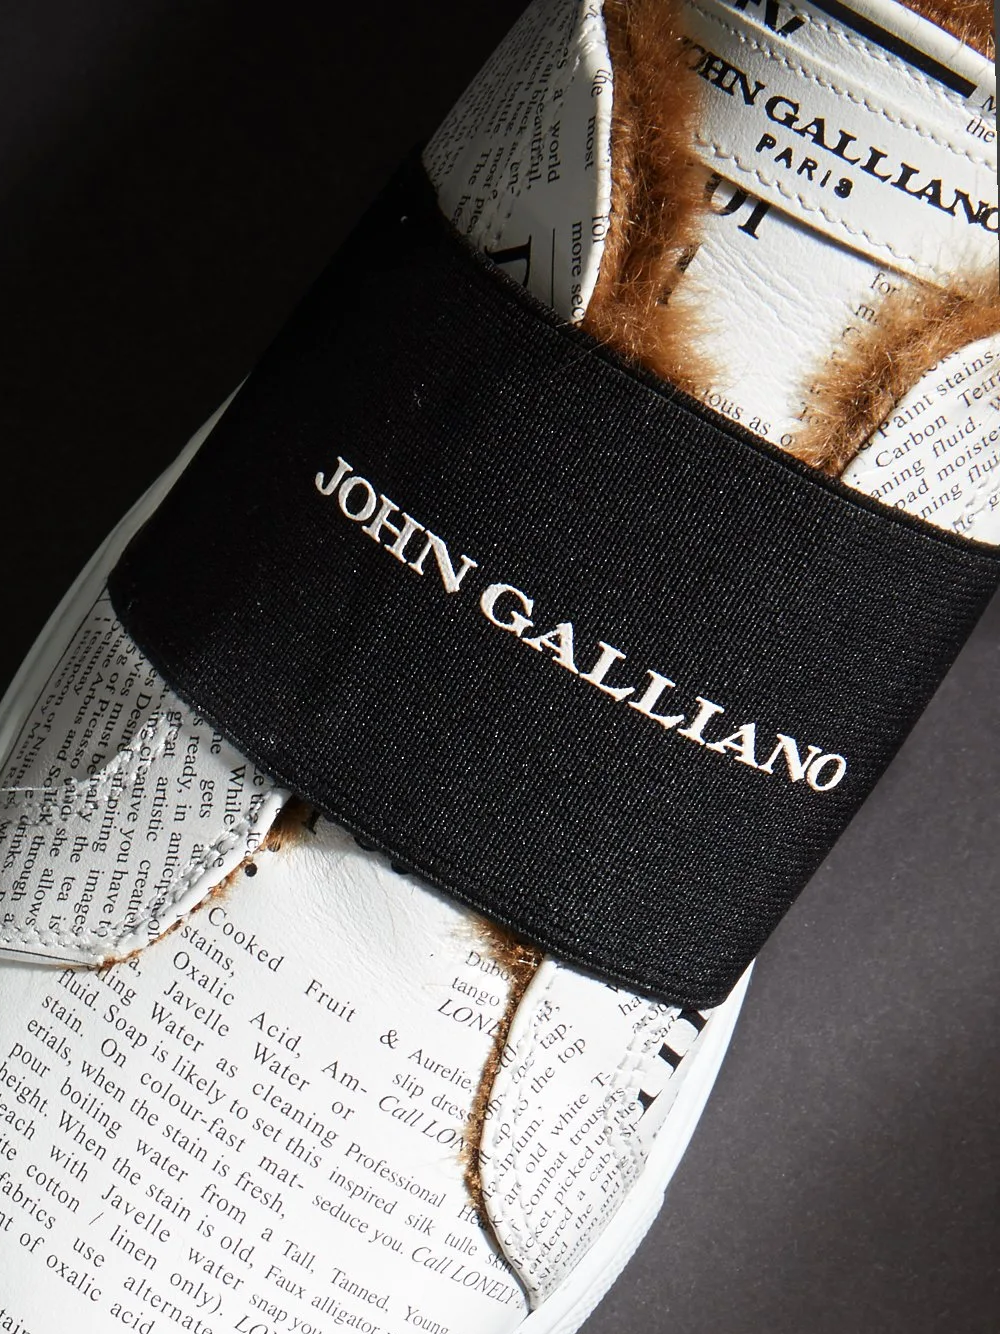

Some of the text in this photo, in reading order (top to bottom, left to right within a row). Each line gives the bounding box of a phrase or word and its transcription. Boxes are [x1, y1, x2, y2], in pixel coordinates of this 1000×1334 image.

[547, 119, 561, 184] world
[584, 115, 597, 171] most
[966, 117, 995, 144] the
[755, 133, 853, 199] PARIS
[571, 220, 583, 277] more
[875, 414, 949, 467] Carbon
[932, 416, 982, 458] fluid.
[315, 456, 847, 792] JOHN GALLIANO
[56, 728, 77, 762] and
[69, 699, 111, 770] Picasso
[98, 702, 124, 748] must
[146, 776, 169, 842] artistic
[173, 735, 200, 822] ready, in
[199, 779, 216, 819] gets
[223, 764, 248, 826] While
[11, 835, 45, 901] through
[49, 827, 75, 901] she tea
[70, 836, 88, 863] the
[103, 829, 136, 914] you have
[25, 868, 55, 926] allows
[180, 926, 235, 978] stains,
[208, 904, 400, 1051] Cooked Fruit &
[172, 951, 368, 1094] Oxalic Acid, Am-
[451, 976, 501, 1008] tango
[57, 968, 323, 1170] fluid. Soap is likely to set this
[163, 979, 356, 1121] Javelle Water or
[530, 1038, 586, 1094] the top
[540, 1023, 573, 1050] tap.
[41, 995, 305, 1190] stain. On colour-fast mat-
[150, 1000, 340, 1150] Water as cleaning
[392, 1073, 425, 1100] slip
[407, 1048, 473, 1094] Aurelie,
[7, 1042, 248, 1226] pour boiling water from
[26, 1019, 286, 1221] erials, when the stain fresh,
[378, 1095, 425, 1128] Call
[525, 1092, 590, 1173] old white
[58, 1108, 108, 1162] When
[112, 1156, 142, 1187] the
[145, 1183, 192, 1223] stain
[219, 1235, 256, 1270] old,
[343, 1142, 448, 1209] Professional
[554, 1145, 598, 1206] picked
[26, 1164, 81, 1215] cotton
[109, 1224, 158, 1271] linen
[169, 1272, 224, 1317] only).
[49, 1144, 89, 1184] with
[100, 1183, 172, 1244] Javelle
[188, 1247, 246, 1291] water
[311, 1194, 370, 1235] seduce
[367, 1229, 404, 1256] you.
[411, 1246, 454, 1275] Call
[328, 1170, 479, 1257] inspired silk tulle
[19, 1232, 46, 1254] of
[46, 1254, 103, 1303] oxalic
[72, 1237, 106, 1269] use
[264, 1264, 307, 1300] Faux
[282, 1239, 317, 1274] Tall,
[330, 1267, 391, 1313] Tanned,
[248, 1294, 289, 1325] snap
